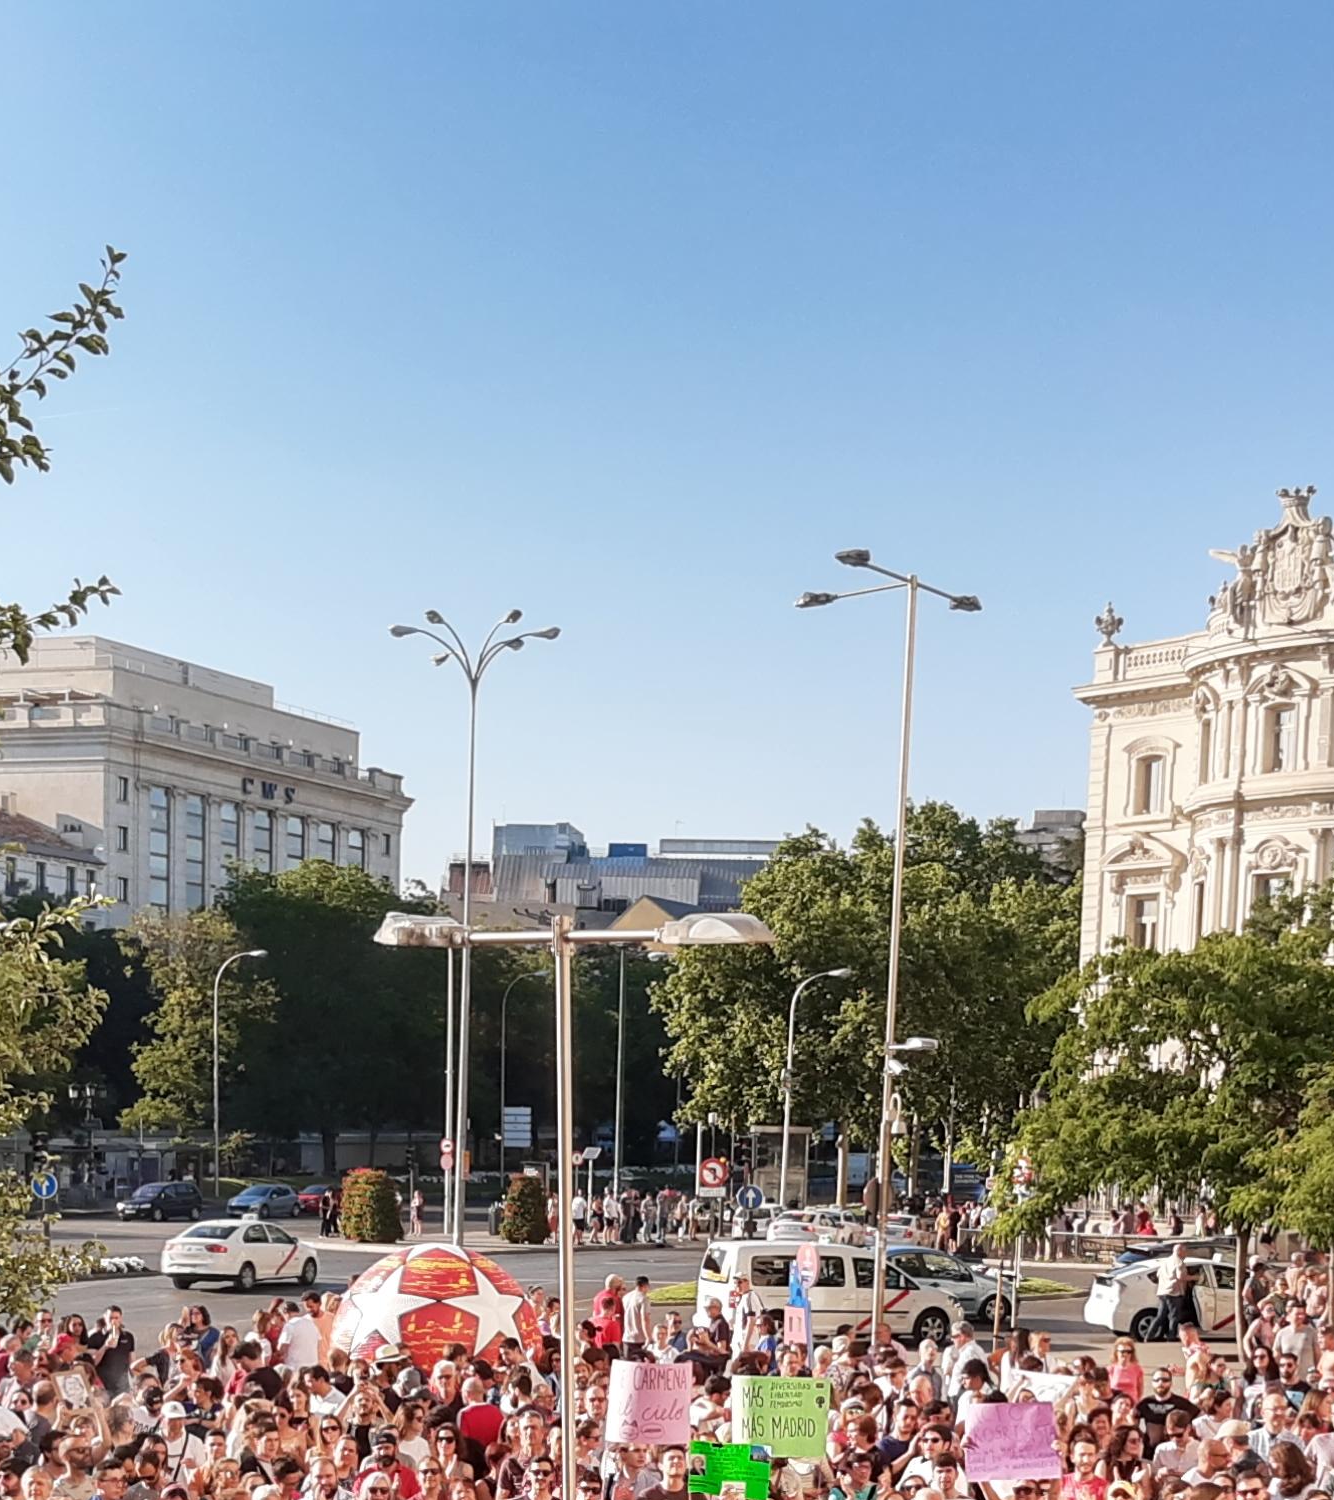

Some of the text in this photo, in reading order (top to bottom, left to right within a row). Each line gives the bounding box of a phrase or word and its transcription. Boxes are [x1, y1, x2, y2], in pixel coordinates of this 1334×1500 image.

[242, 777, 295, 804] CWS
[633, 1366, 687, 1391] CARMENA
[742, 1382, 764, 1408] MÁS
[742, 1415, 816, 1439] MÁS MADRID
